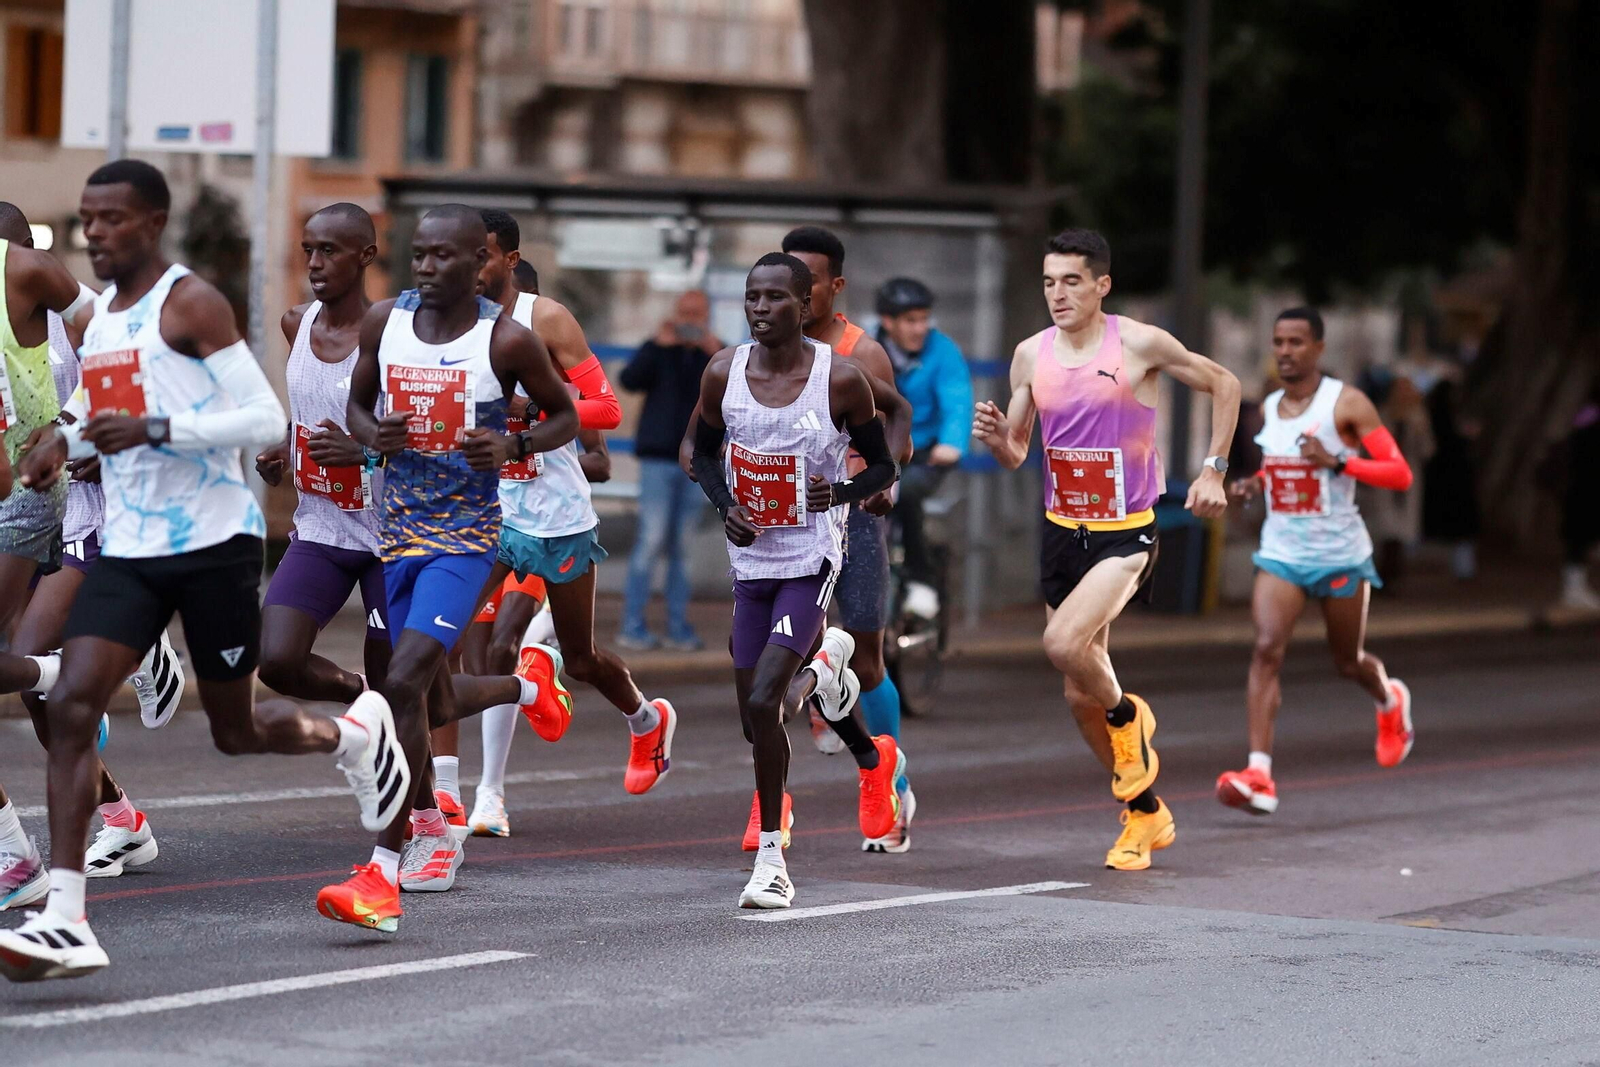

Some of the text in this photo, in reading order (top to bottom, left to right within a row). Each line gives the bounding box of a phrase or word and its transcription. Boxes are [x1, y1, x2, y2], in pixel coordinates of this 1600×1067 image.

[403, 367, 460, 382] GENERALI
[400, 381, 445, 393] BUSHEN-
[409, 395, 435, 407] DICH
[415, 405, 429, 416] 13
[743, 451, 789, 466] GENERALI
[1062, 451, 1109, 462] GENERALI
[319, 466, 327, 477] 14
[740, 466, 780, 481] ZACHARIA
[1073, 468, 1084, 477] 26
[751, 485, 762, 496] 15
